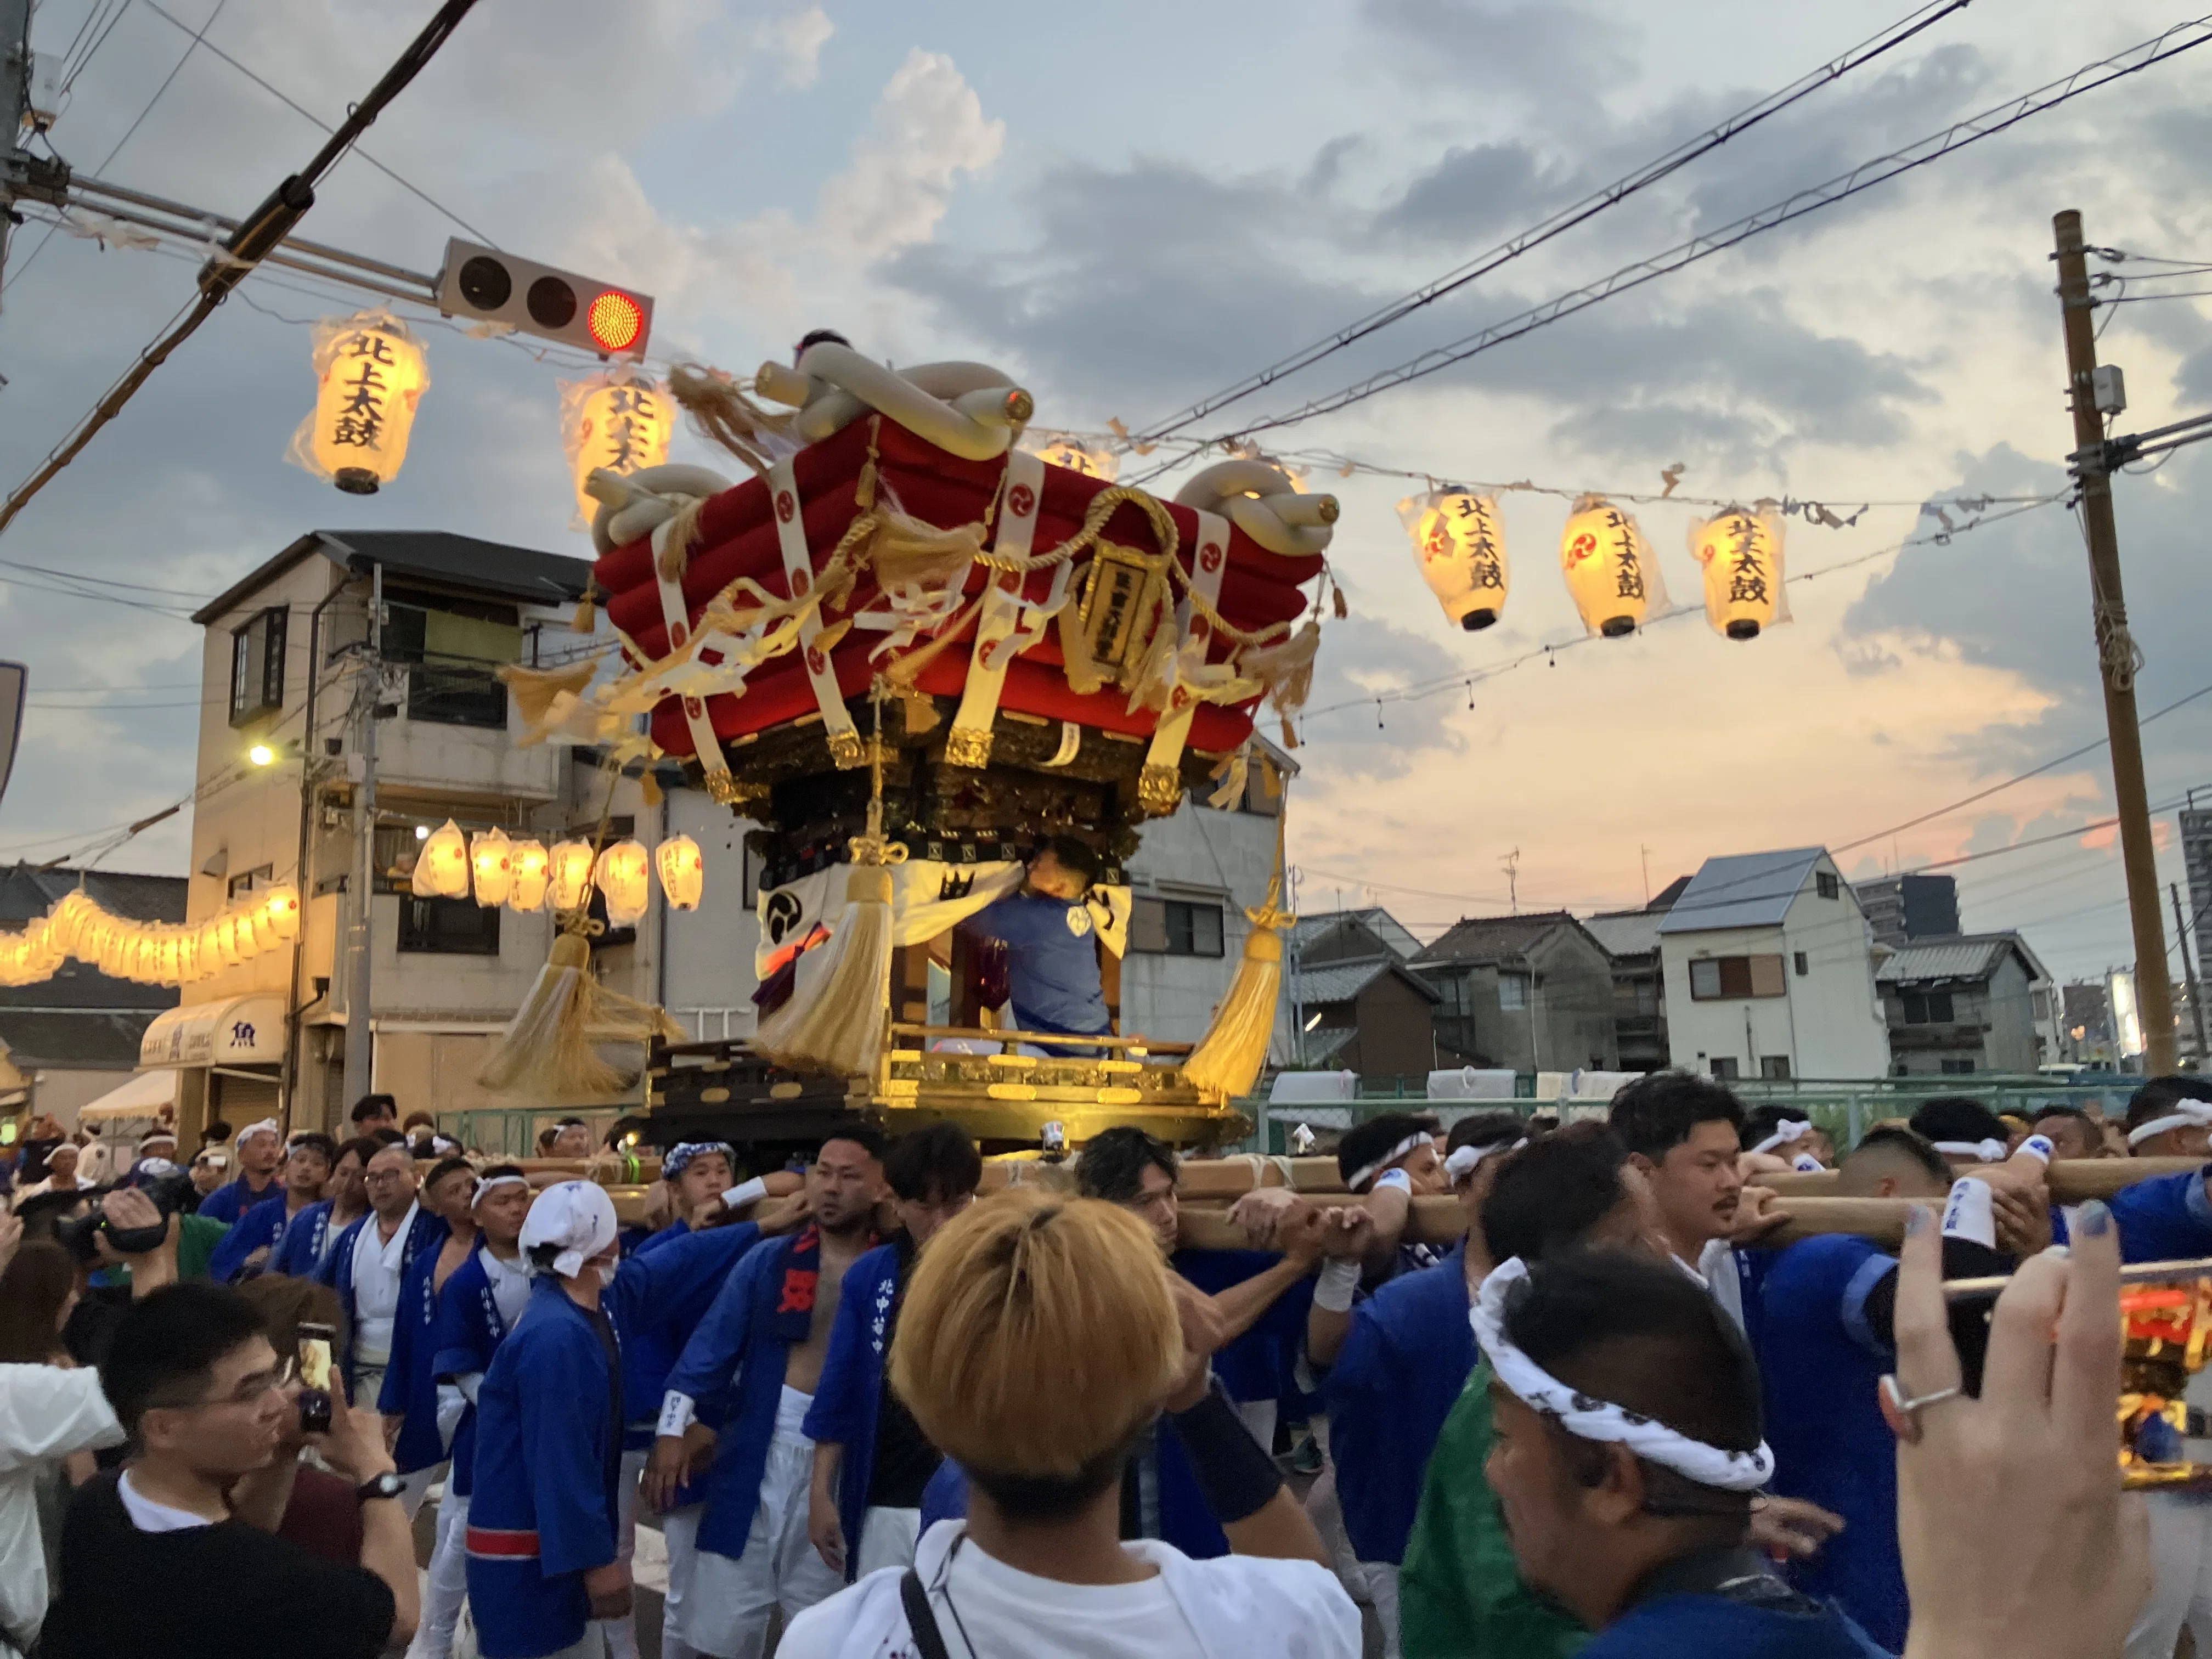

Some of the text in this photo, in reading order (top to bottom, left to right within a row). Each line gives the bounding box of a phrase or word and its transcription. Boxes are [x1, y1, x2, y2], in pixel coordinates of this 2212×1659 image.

[332, 335, 395, 453] 北上太鼓
[1457, 498, 1505, 591] 北上太鼓
[1606, 511, 1646, 603] 北上太鼓
[1728, 520, 1769, 605] 北上太鼓
